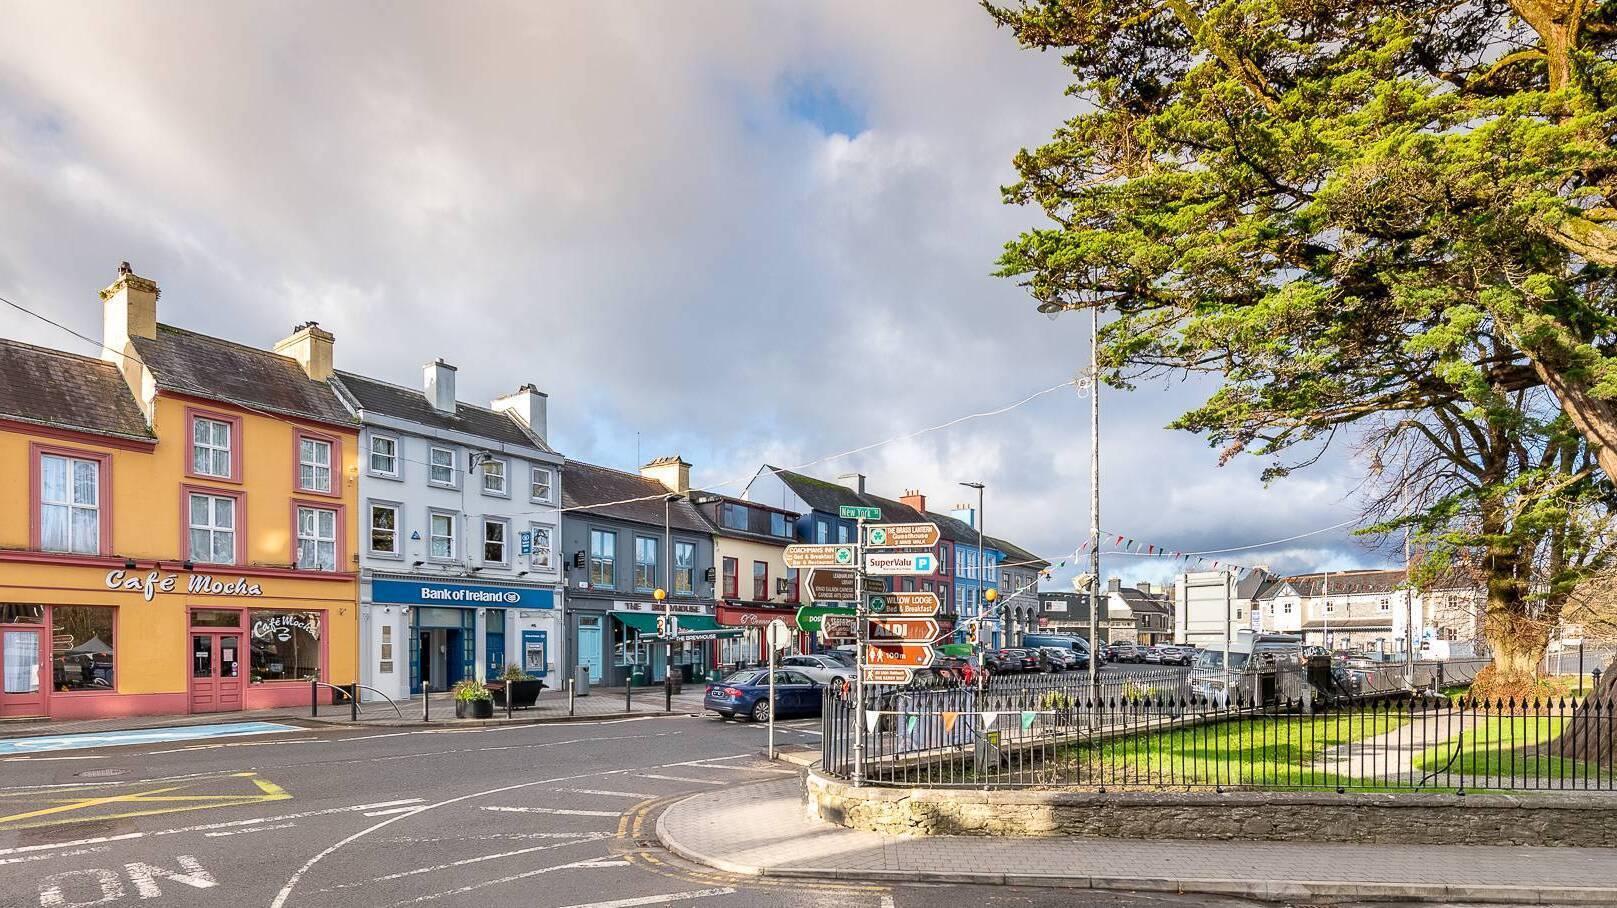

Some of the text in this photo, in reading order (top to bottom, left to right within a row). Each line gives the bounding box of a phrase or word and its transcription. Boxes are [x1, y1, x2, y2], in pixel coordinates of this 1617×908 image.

[841, 507, 856, 516] New
[857, 508, 871, 517] York
[870, 558, 912, 567] SuperValu
[105, 569, 264, 601] Café Mocha
[421, 587, 503, 602] Bank of Ireland
[886, 596, 933, 604] WILLOW LODGE
[625, 602, 642, 610] THE
[254, 615, 318, 638] Café Mocha
[874, 623, 908, 637] ALDI
[686, 633, 717, 641] BREWHOUSE
